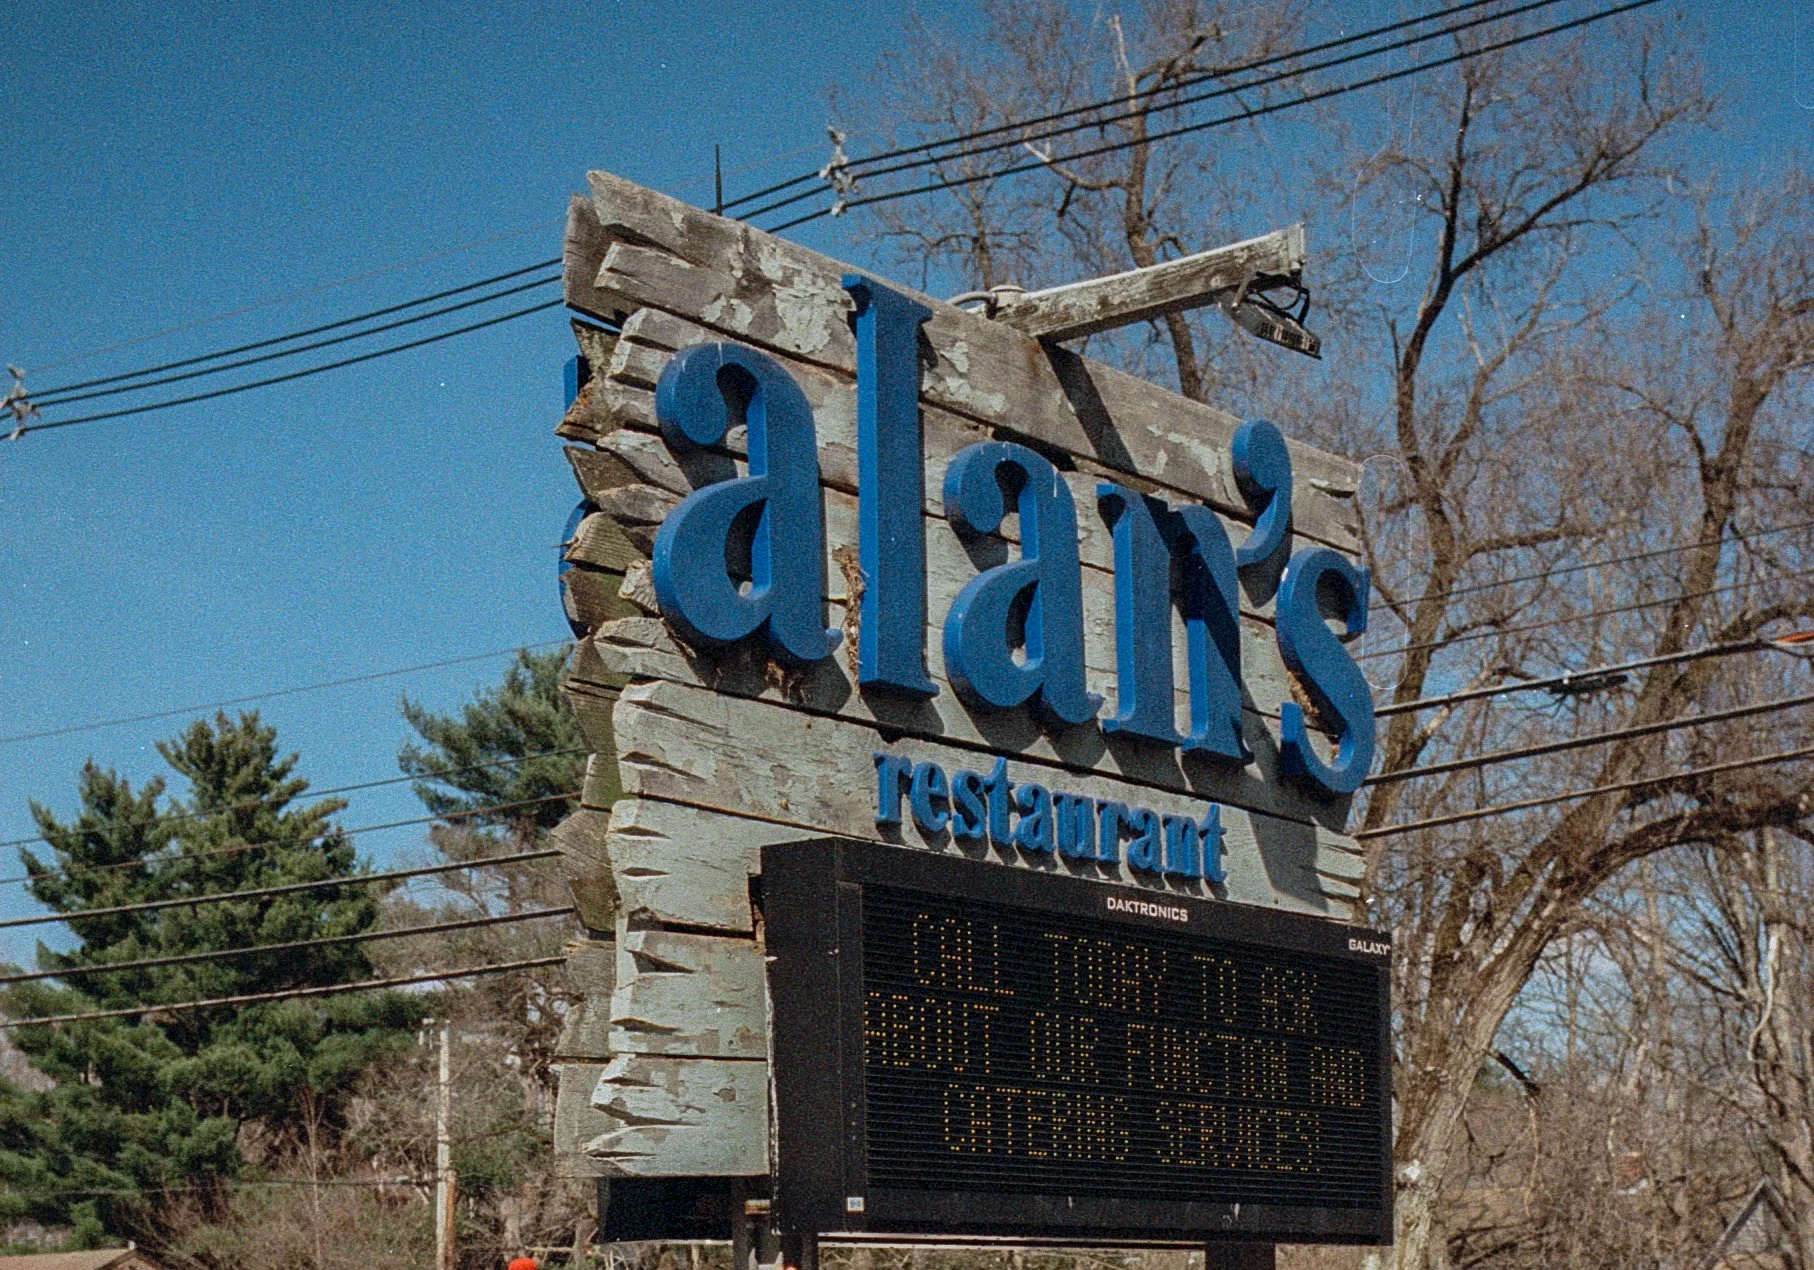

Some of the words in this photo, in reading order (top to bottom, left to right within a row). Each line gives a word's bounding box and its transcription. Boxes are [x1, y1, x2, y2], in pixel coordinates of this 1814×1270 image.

[651, 274, 1376, 793] alan's
[872, 750, 1228, 884] restaurant
[1106, 896, 1189, 923] DAKTRONICS
[913, 913, 1015, 996] CALL
[1043, 932, 1167, 1014] TODAY
[1193, 955, 1237, 1024] TO
[1261, 966, 1318, 1034] ASK
[864, 992, 1000, 1074] ABOUT
[1029, 1011, 1100, 1083] OUR
[1127, 1023, 1288, 1099] FUNCTION
[1310, 1046, 1365, 1107] AND
[944, 1083, 1128, 1161] CATERING
